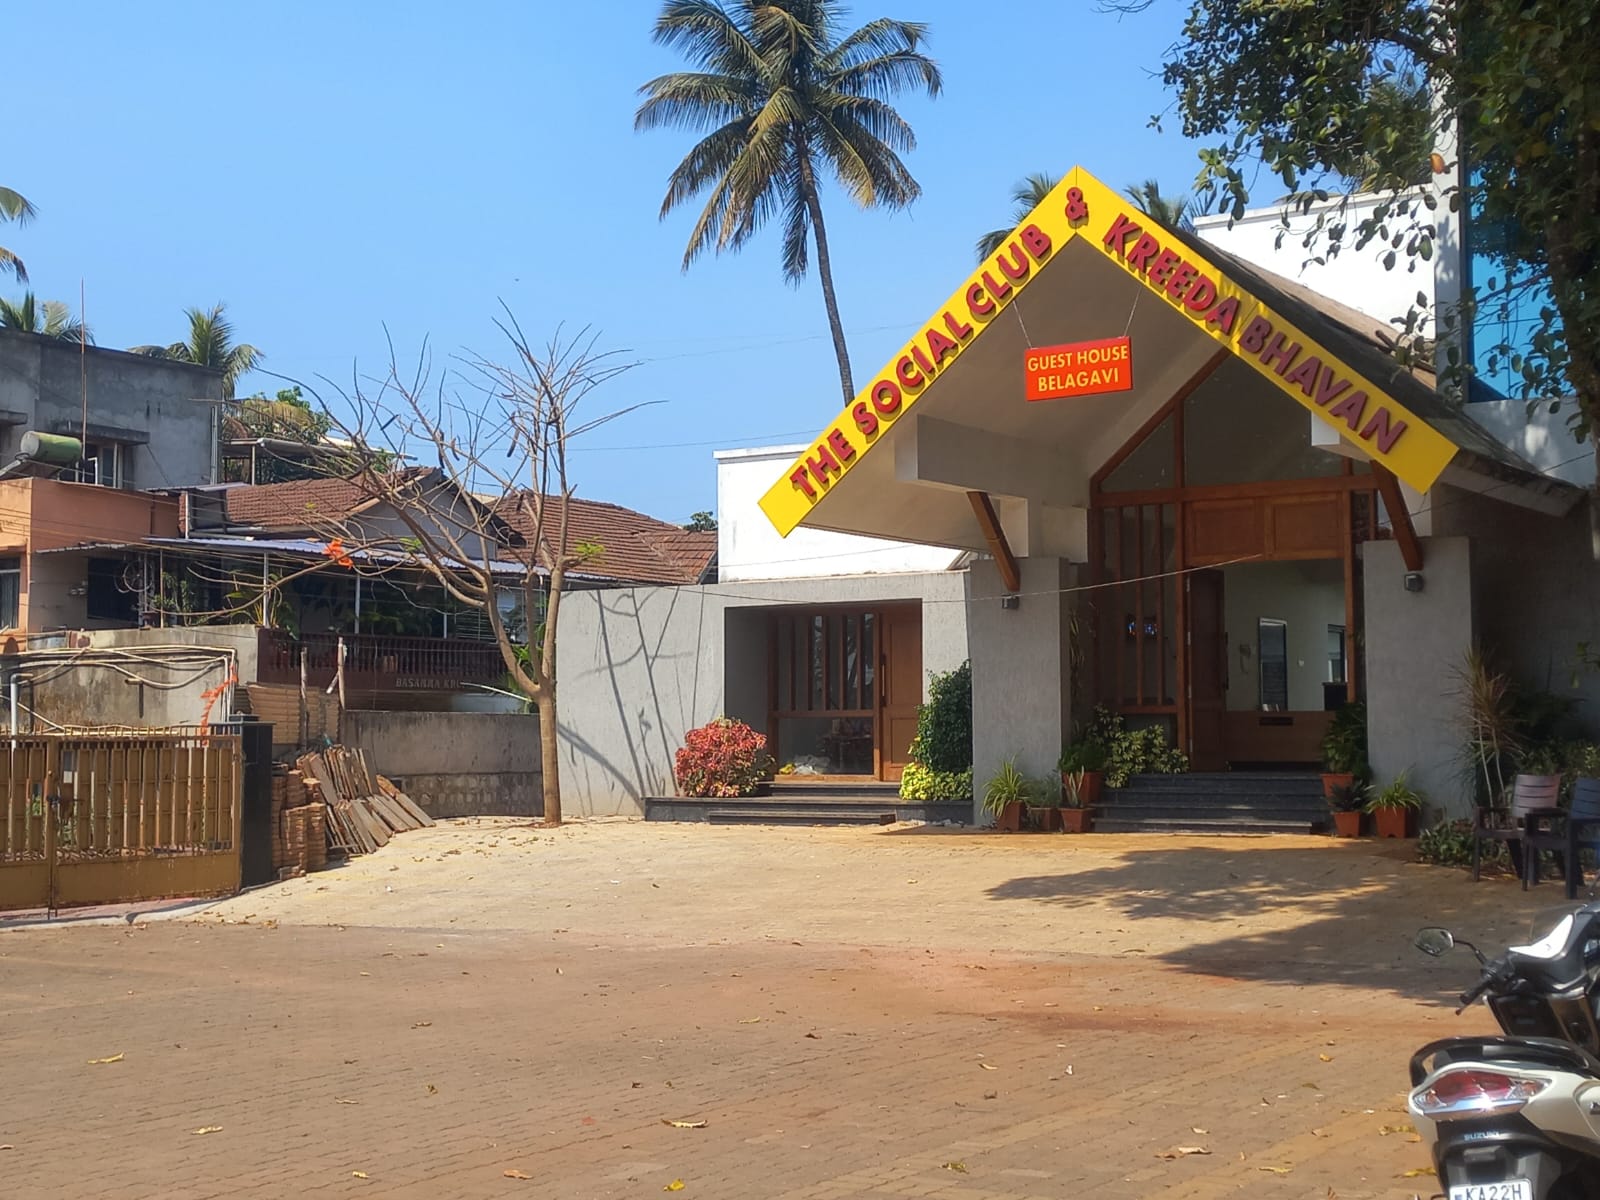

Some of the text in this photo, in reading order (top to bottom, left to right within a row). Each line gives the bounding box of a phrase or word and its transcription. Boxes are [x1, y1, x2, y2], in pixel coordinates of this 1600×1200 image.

[790, 187, 1407, 498] THE SOCIAL CLUB & KREEDA BHAVAN
[1027, 345, 1128, 372] GUEST HOUSE
[1038, 367, 1119, 392] BELAGAVI
